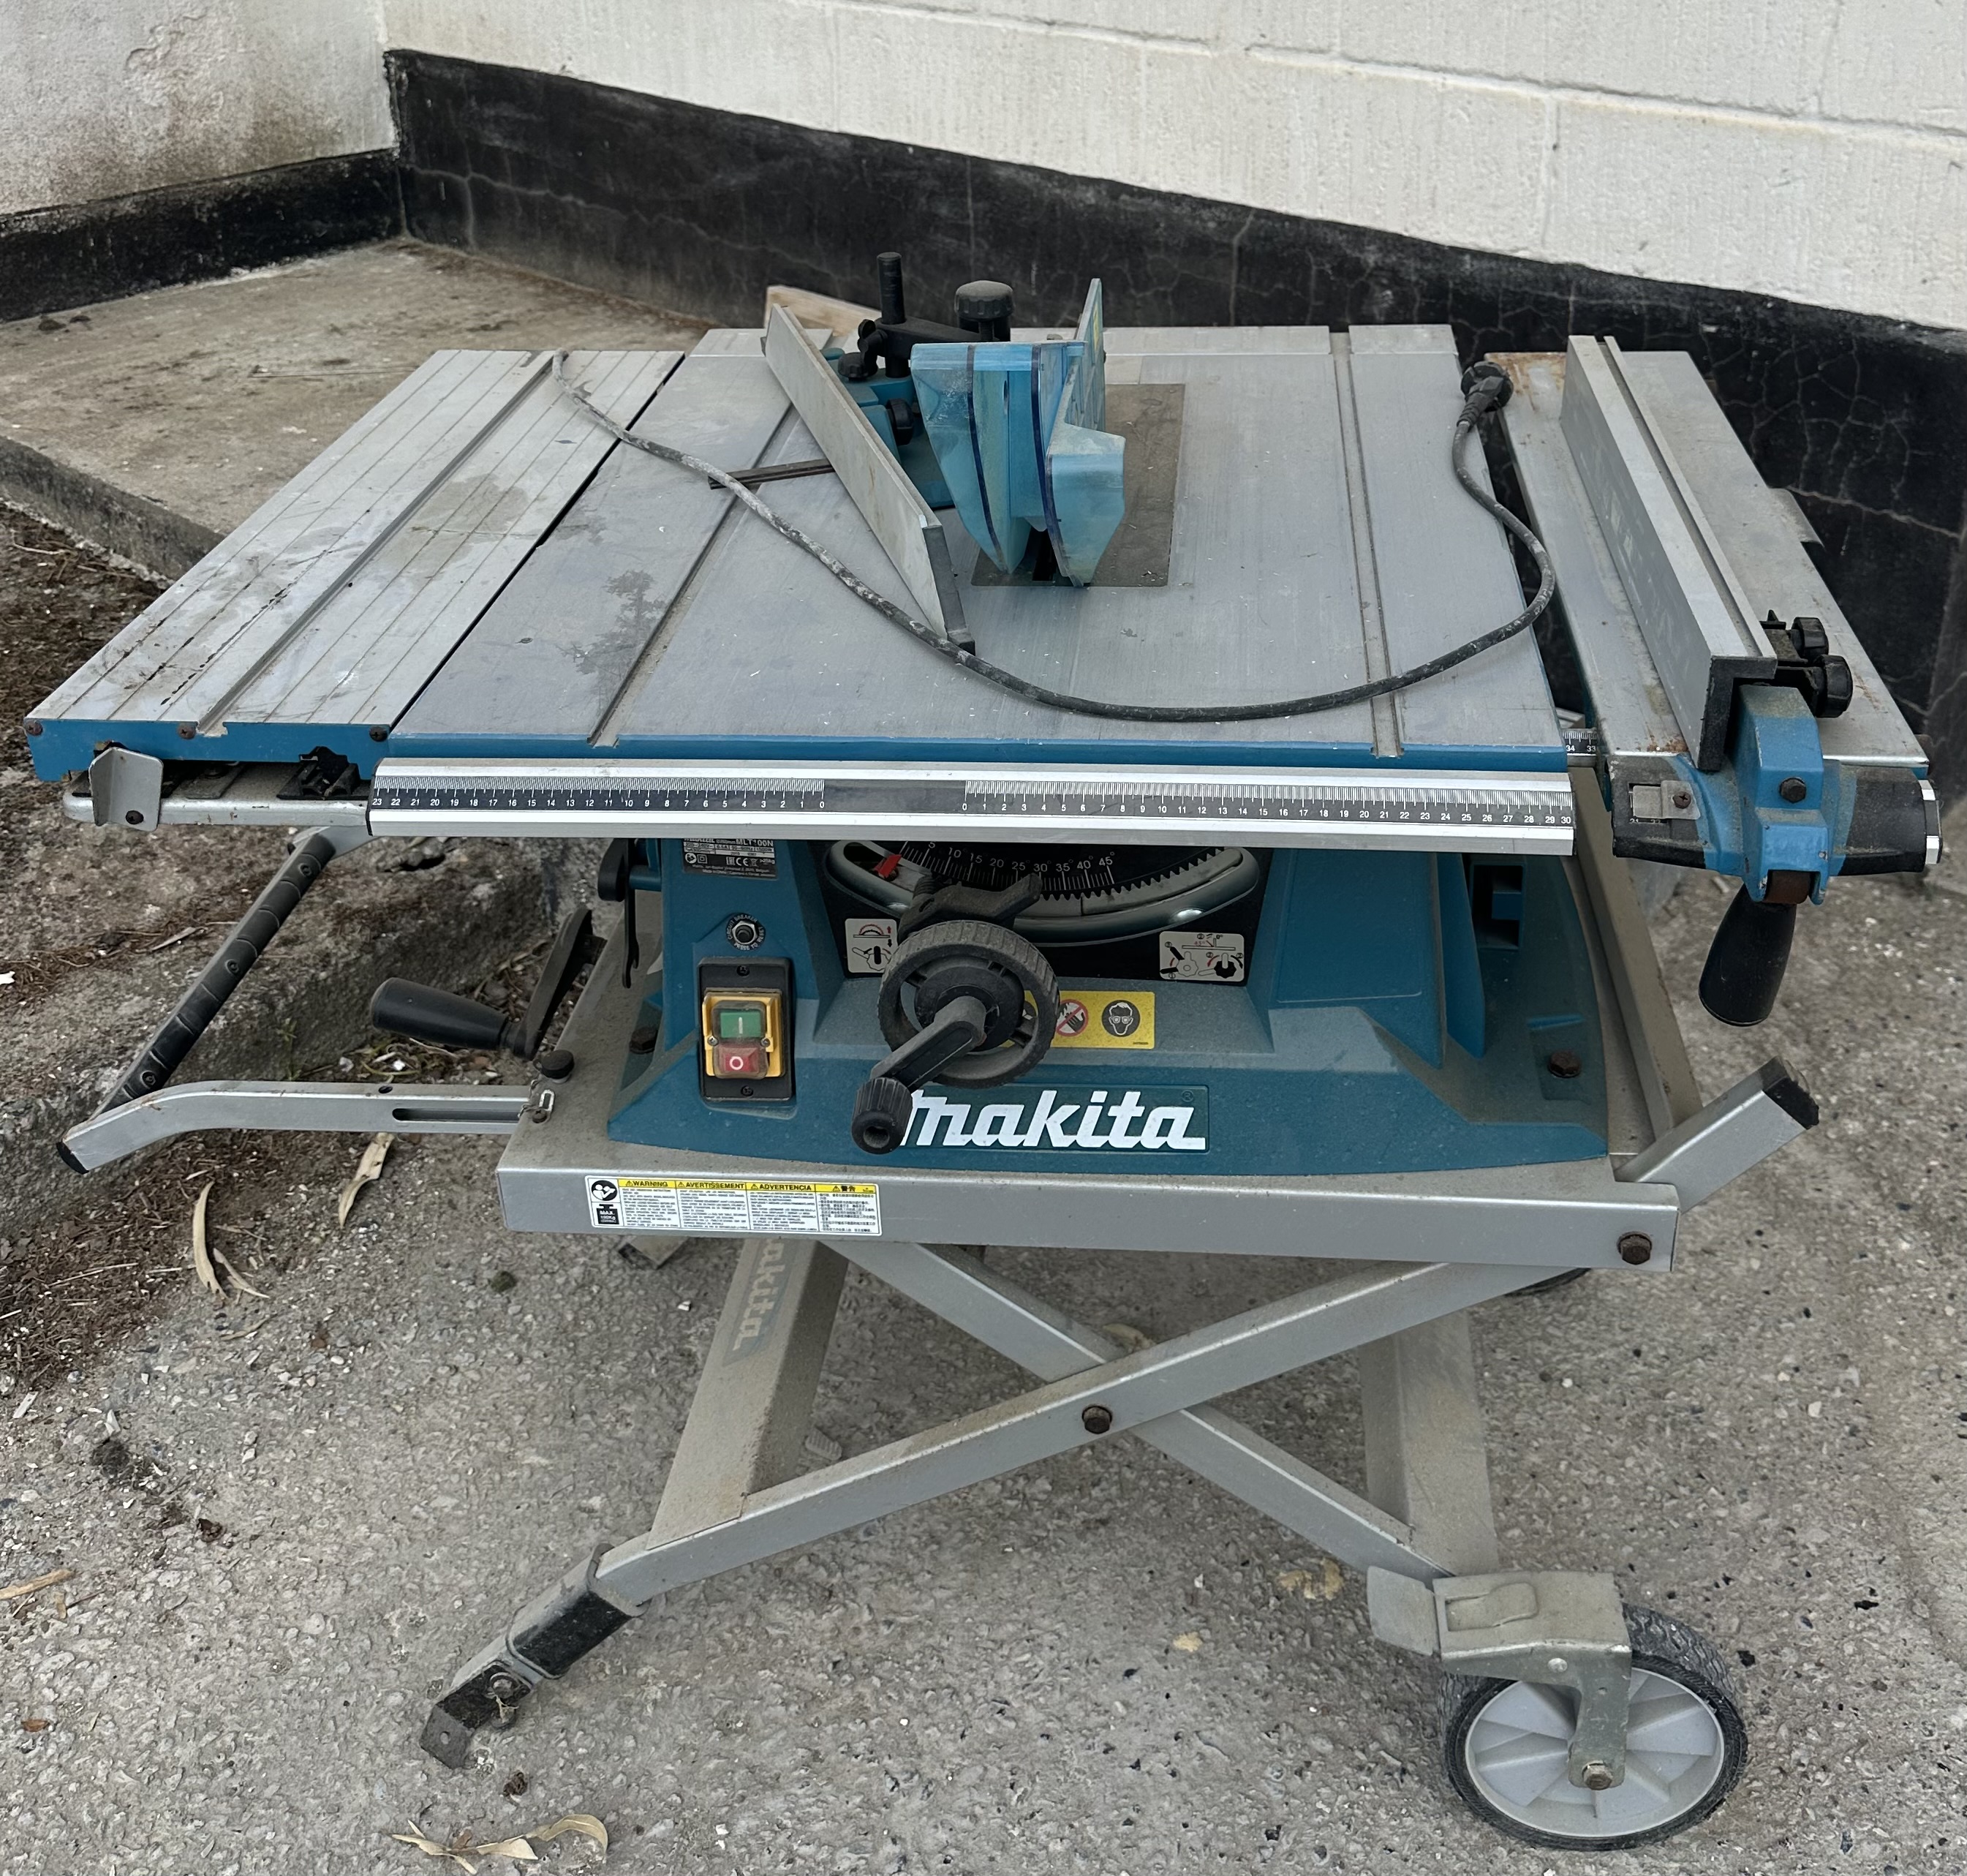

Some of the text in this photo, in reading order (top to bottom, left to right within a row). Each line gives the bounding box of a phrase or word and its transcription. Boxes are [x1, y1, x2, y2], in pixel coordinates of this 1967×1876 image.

[1587, 745, 1596, 753] 33
[429, 799, 440, 807] 20
[566, 799, 575, 807] 13
[779, 800, 786, 808] 2
[1503, 815, 1514, 823] 27
[1524, 815, 1535, 824] 28
[1544, 816, 1555, 824] 29
[1560, 816, 1571, 824] 30
[900, 1090, 1207, 1150] makita
[733, 1240, 785, 1351] akita
